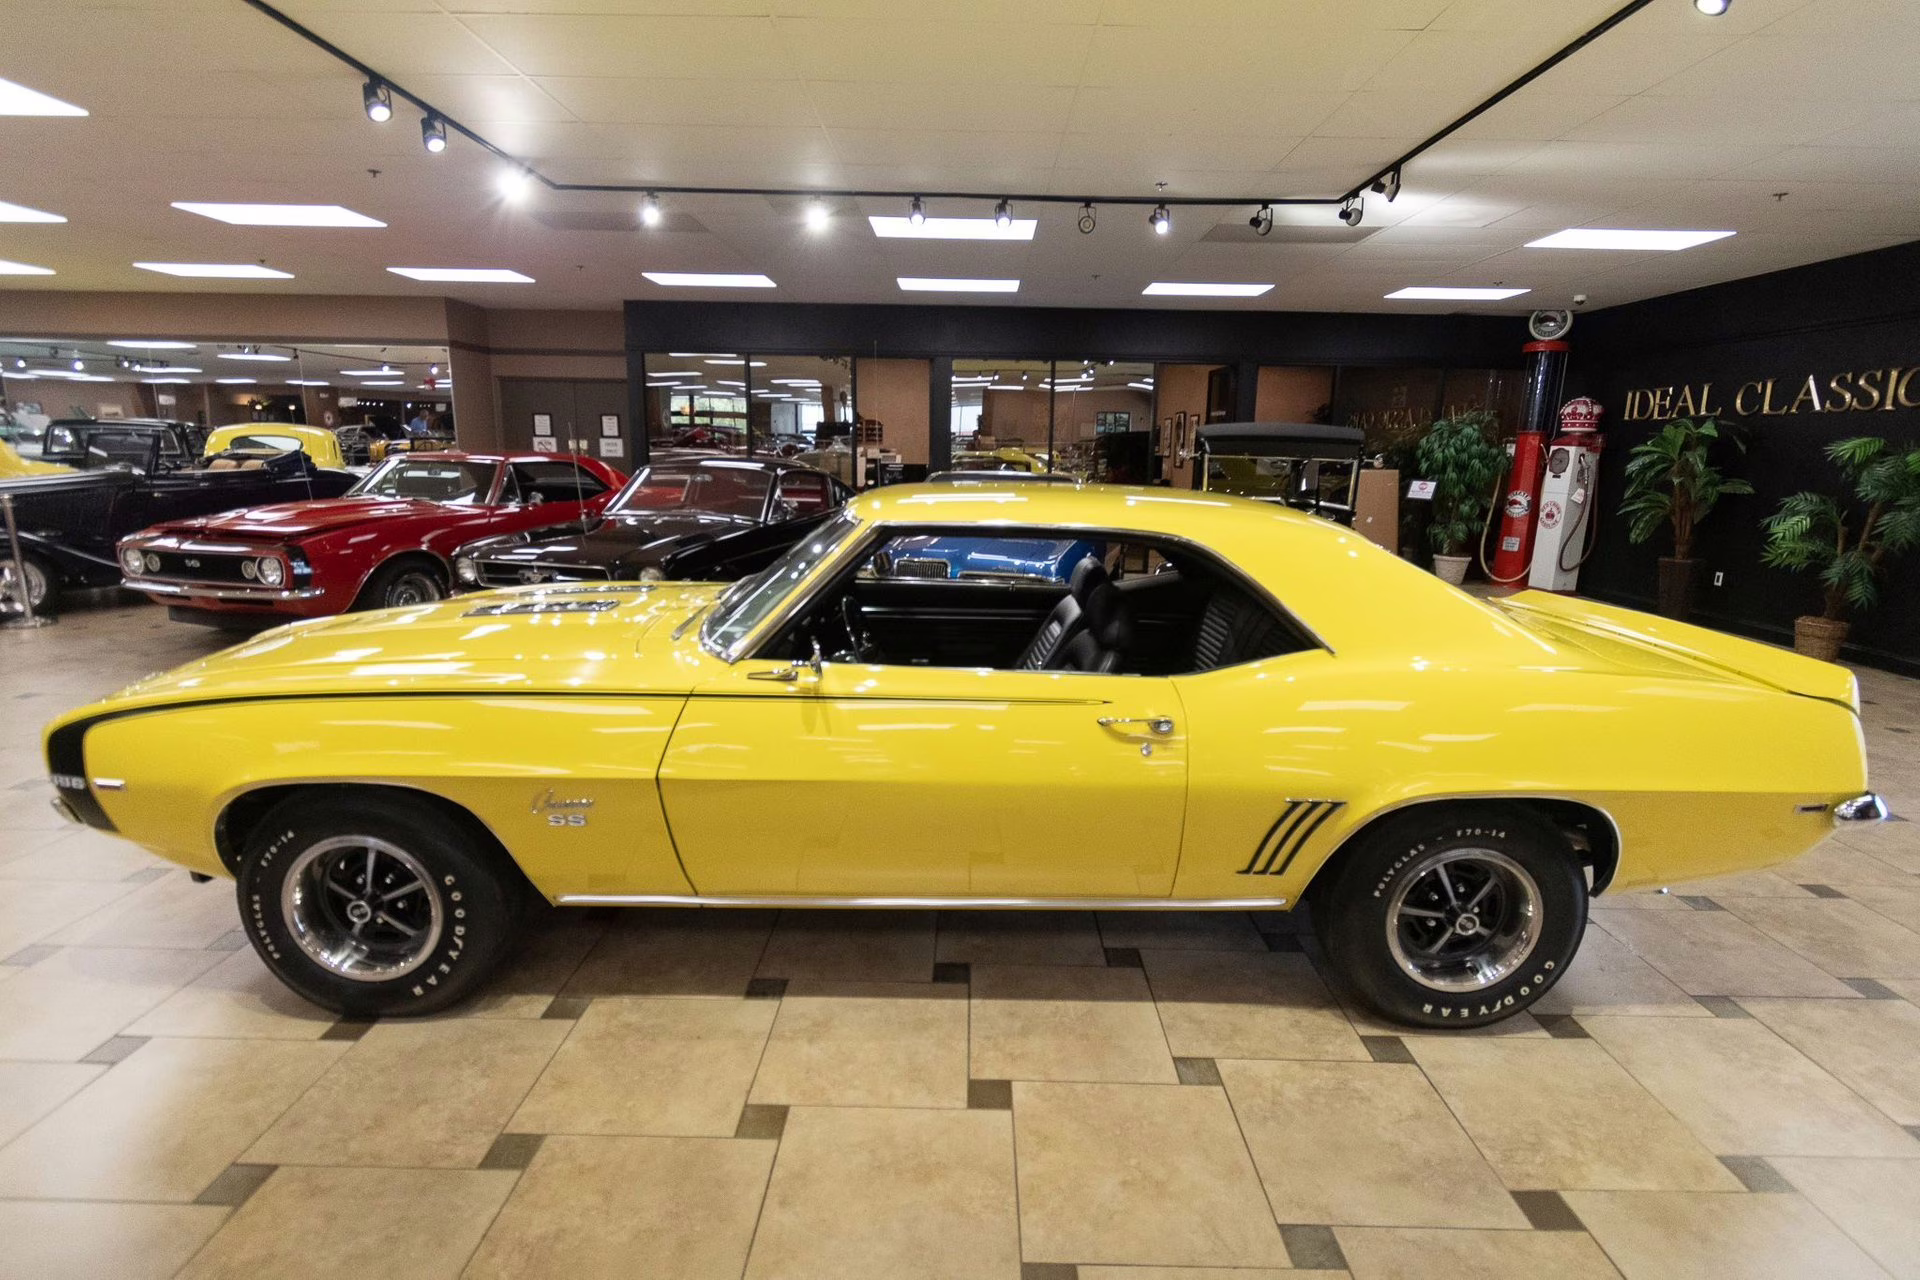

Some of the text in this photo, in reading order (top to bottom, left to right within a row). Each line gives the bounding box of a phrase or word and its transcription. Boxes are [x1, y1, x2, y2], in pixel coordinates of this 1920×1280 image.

[1623, 366, 1920, 420] IDEAL CLASSIC
[547, 814, 587, 827] SS
[1373, 844, 1425, 897] POLYGLAS
[412, 875, 466, 997] GOODYEAR
[1422, 960, 1555, 1018] GOODYEAR
